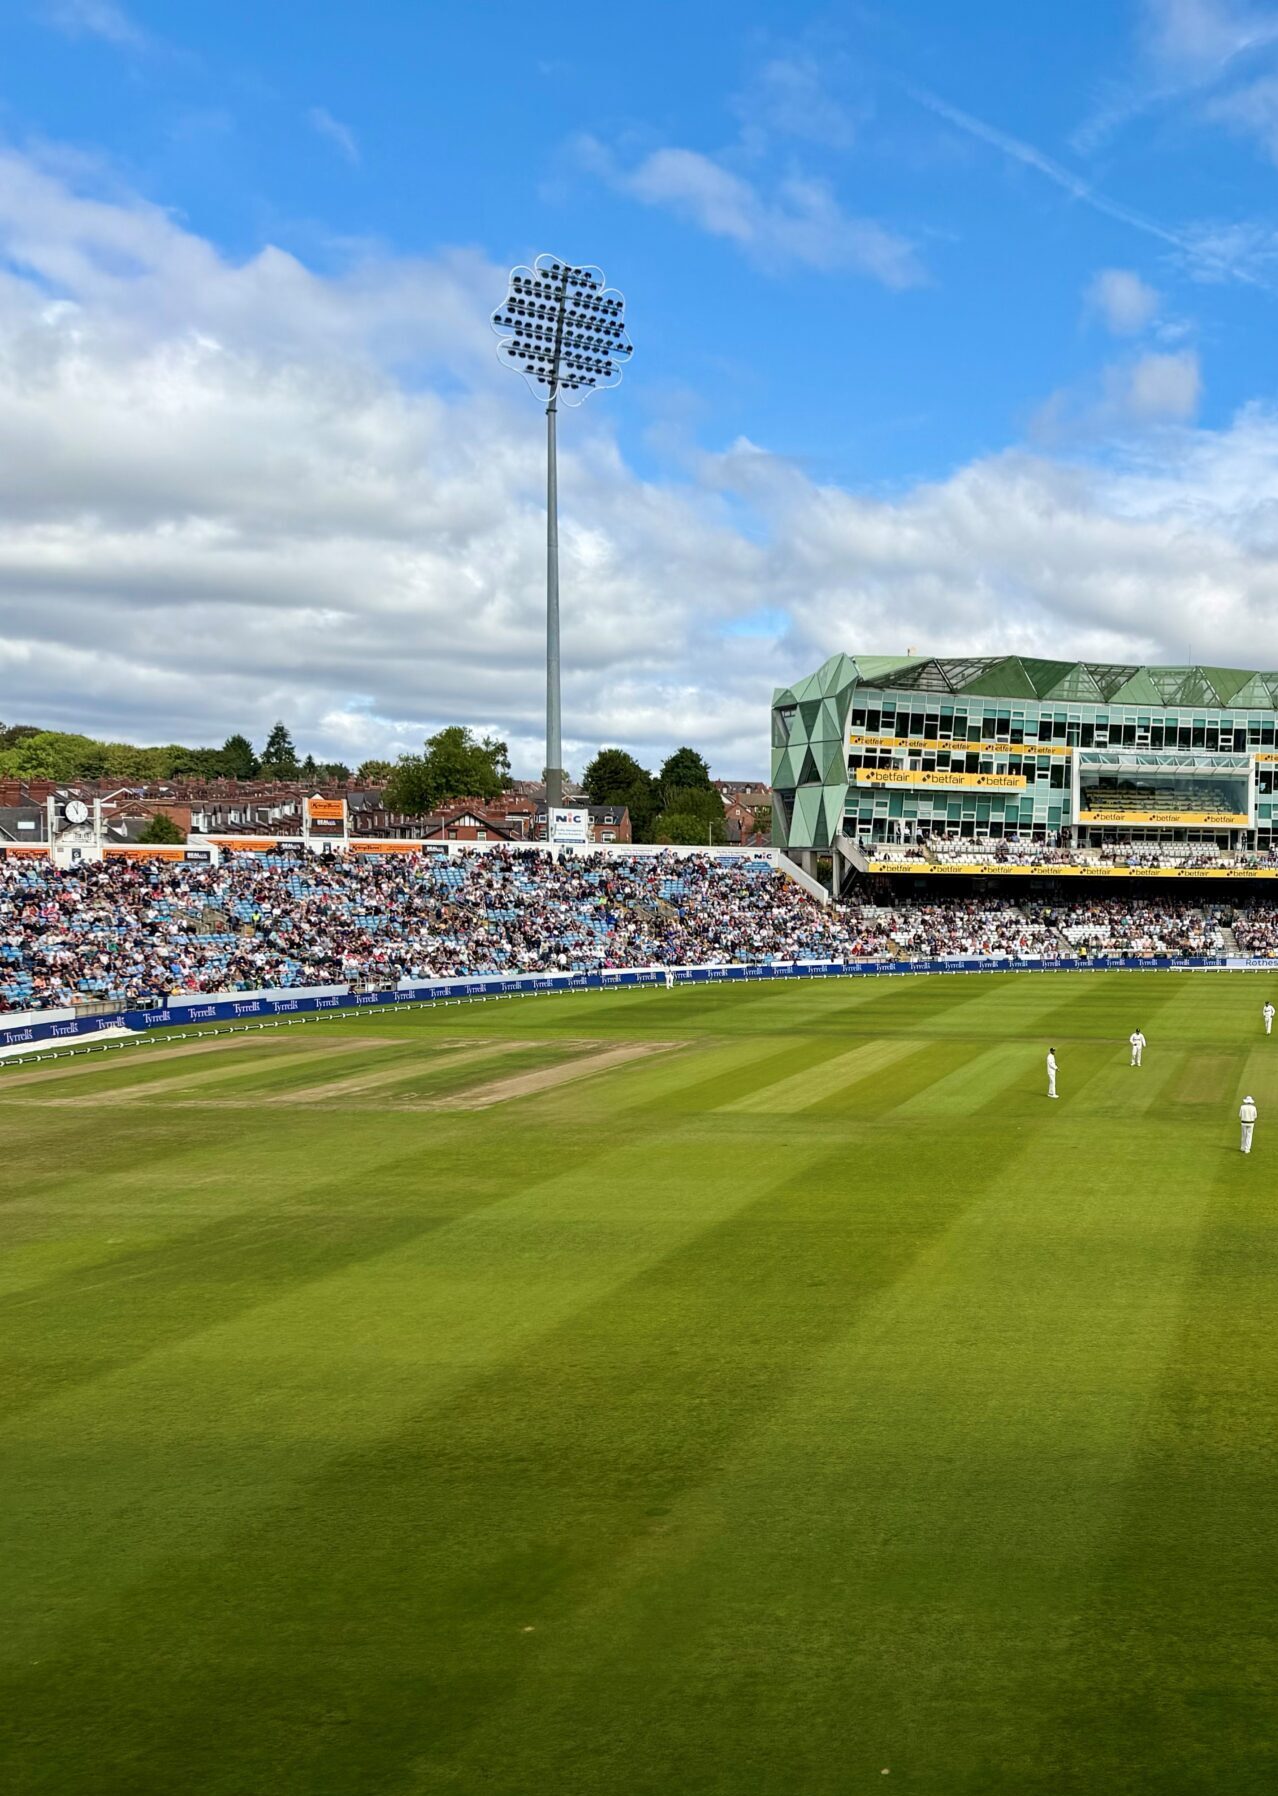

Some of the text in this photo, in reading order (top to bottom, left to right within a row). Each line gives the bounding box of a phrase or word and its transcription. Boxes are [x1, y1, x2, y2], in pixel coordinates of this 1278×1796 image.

[876, 772, 910, 782] betfair
[932, 774, 965, 784] betfair
[986, 776, 1020, 786] betfair
[1156, 814, 1180, 822] betfair
[988, 866, 1014, 874] betfair
